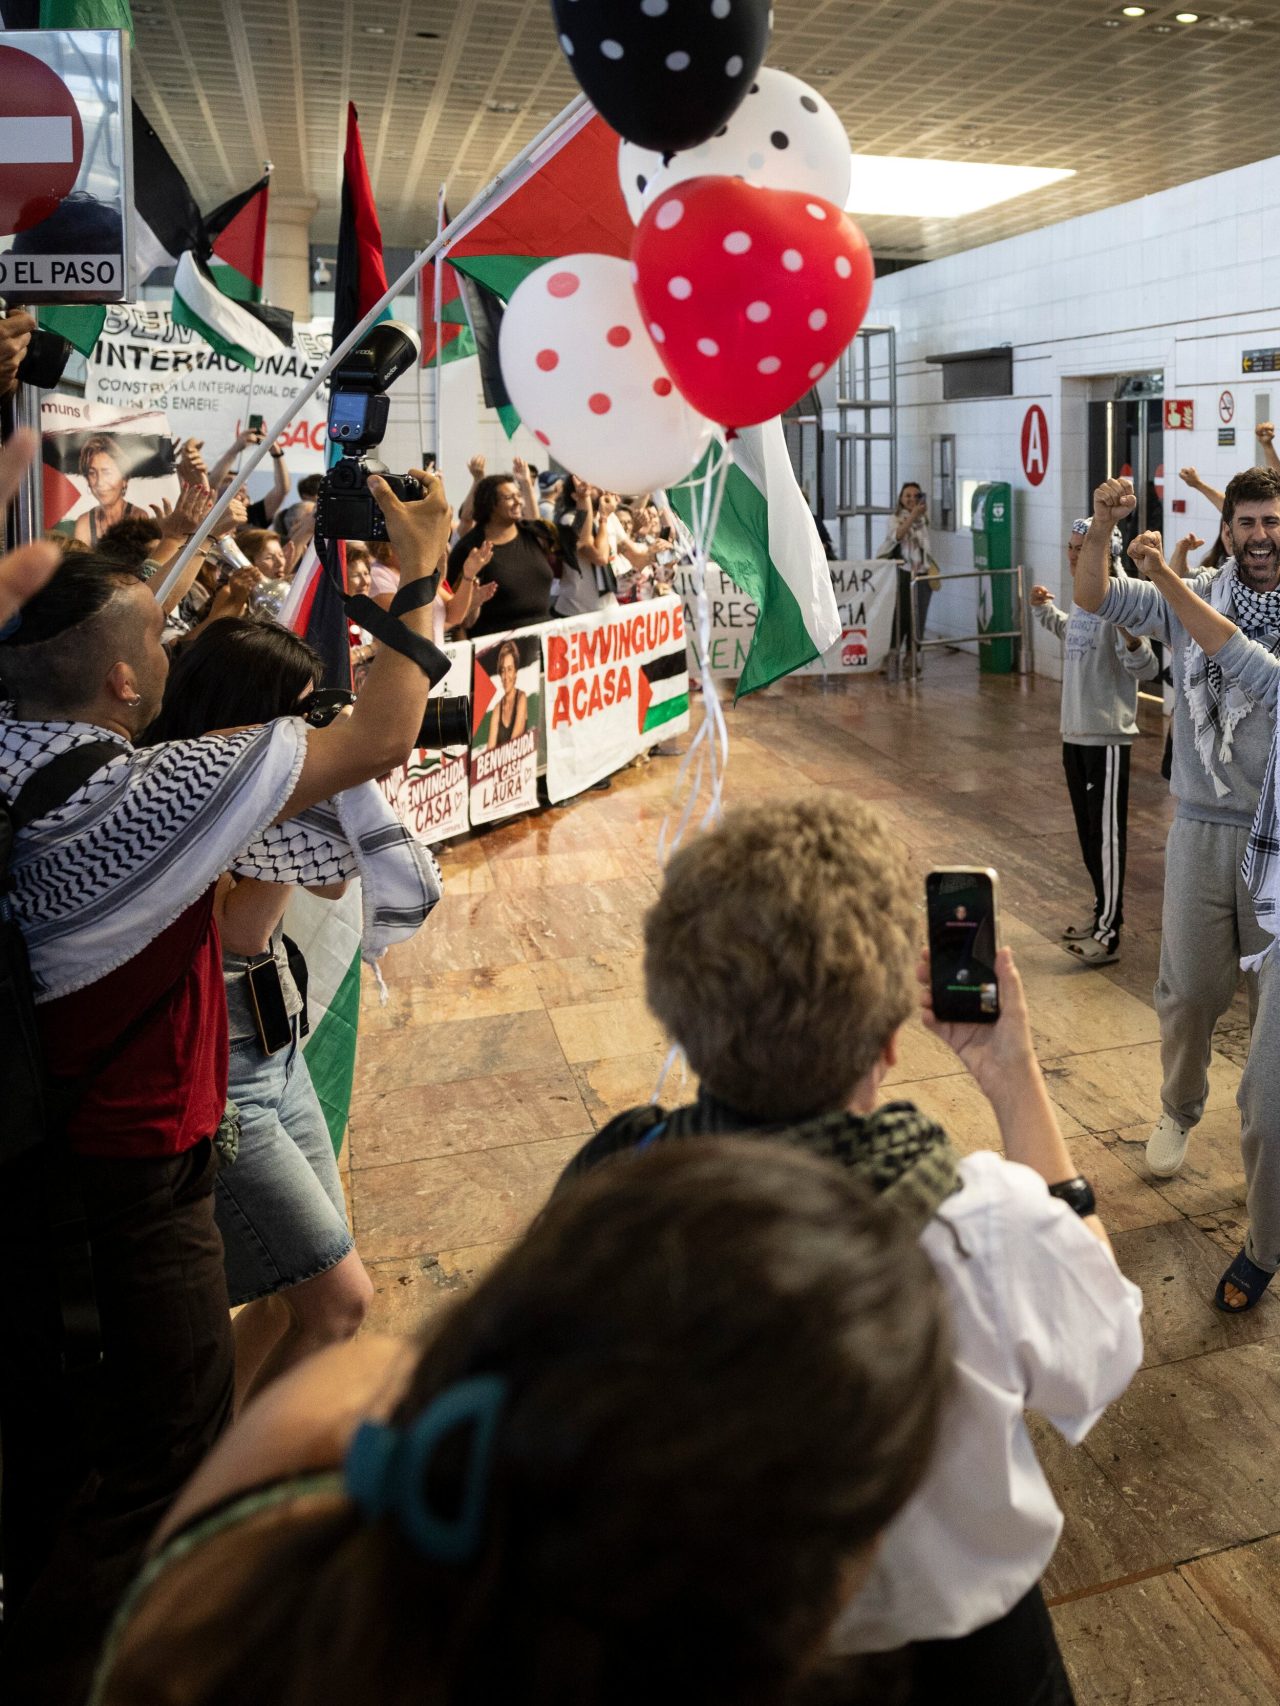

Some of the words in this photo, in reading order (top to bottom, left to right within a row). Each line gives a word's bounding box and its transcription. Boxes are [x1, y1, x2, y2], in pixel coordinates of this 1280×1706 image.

[14, 261, 43, 284] EL
[51, 260, 115, 284] PASO
[281, 386, 299, 399] DE
[1026, 410, 1044, 474] A
[842, 654, 867, 665] CGT
[477, 731, 535, 780] BENVINGUDA
[501, 759, 522, 779] CASA
[483, 778, 522, 809] LAURA
[415, 793, 452, 833] CASA
